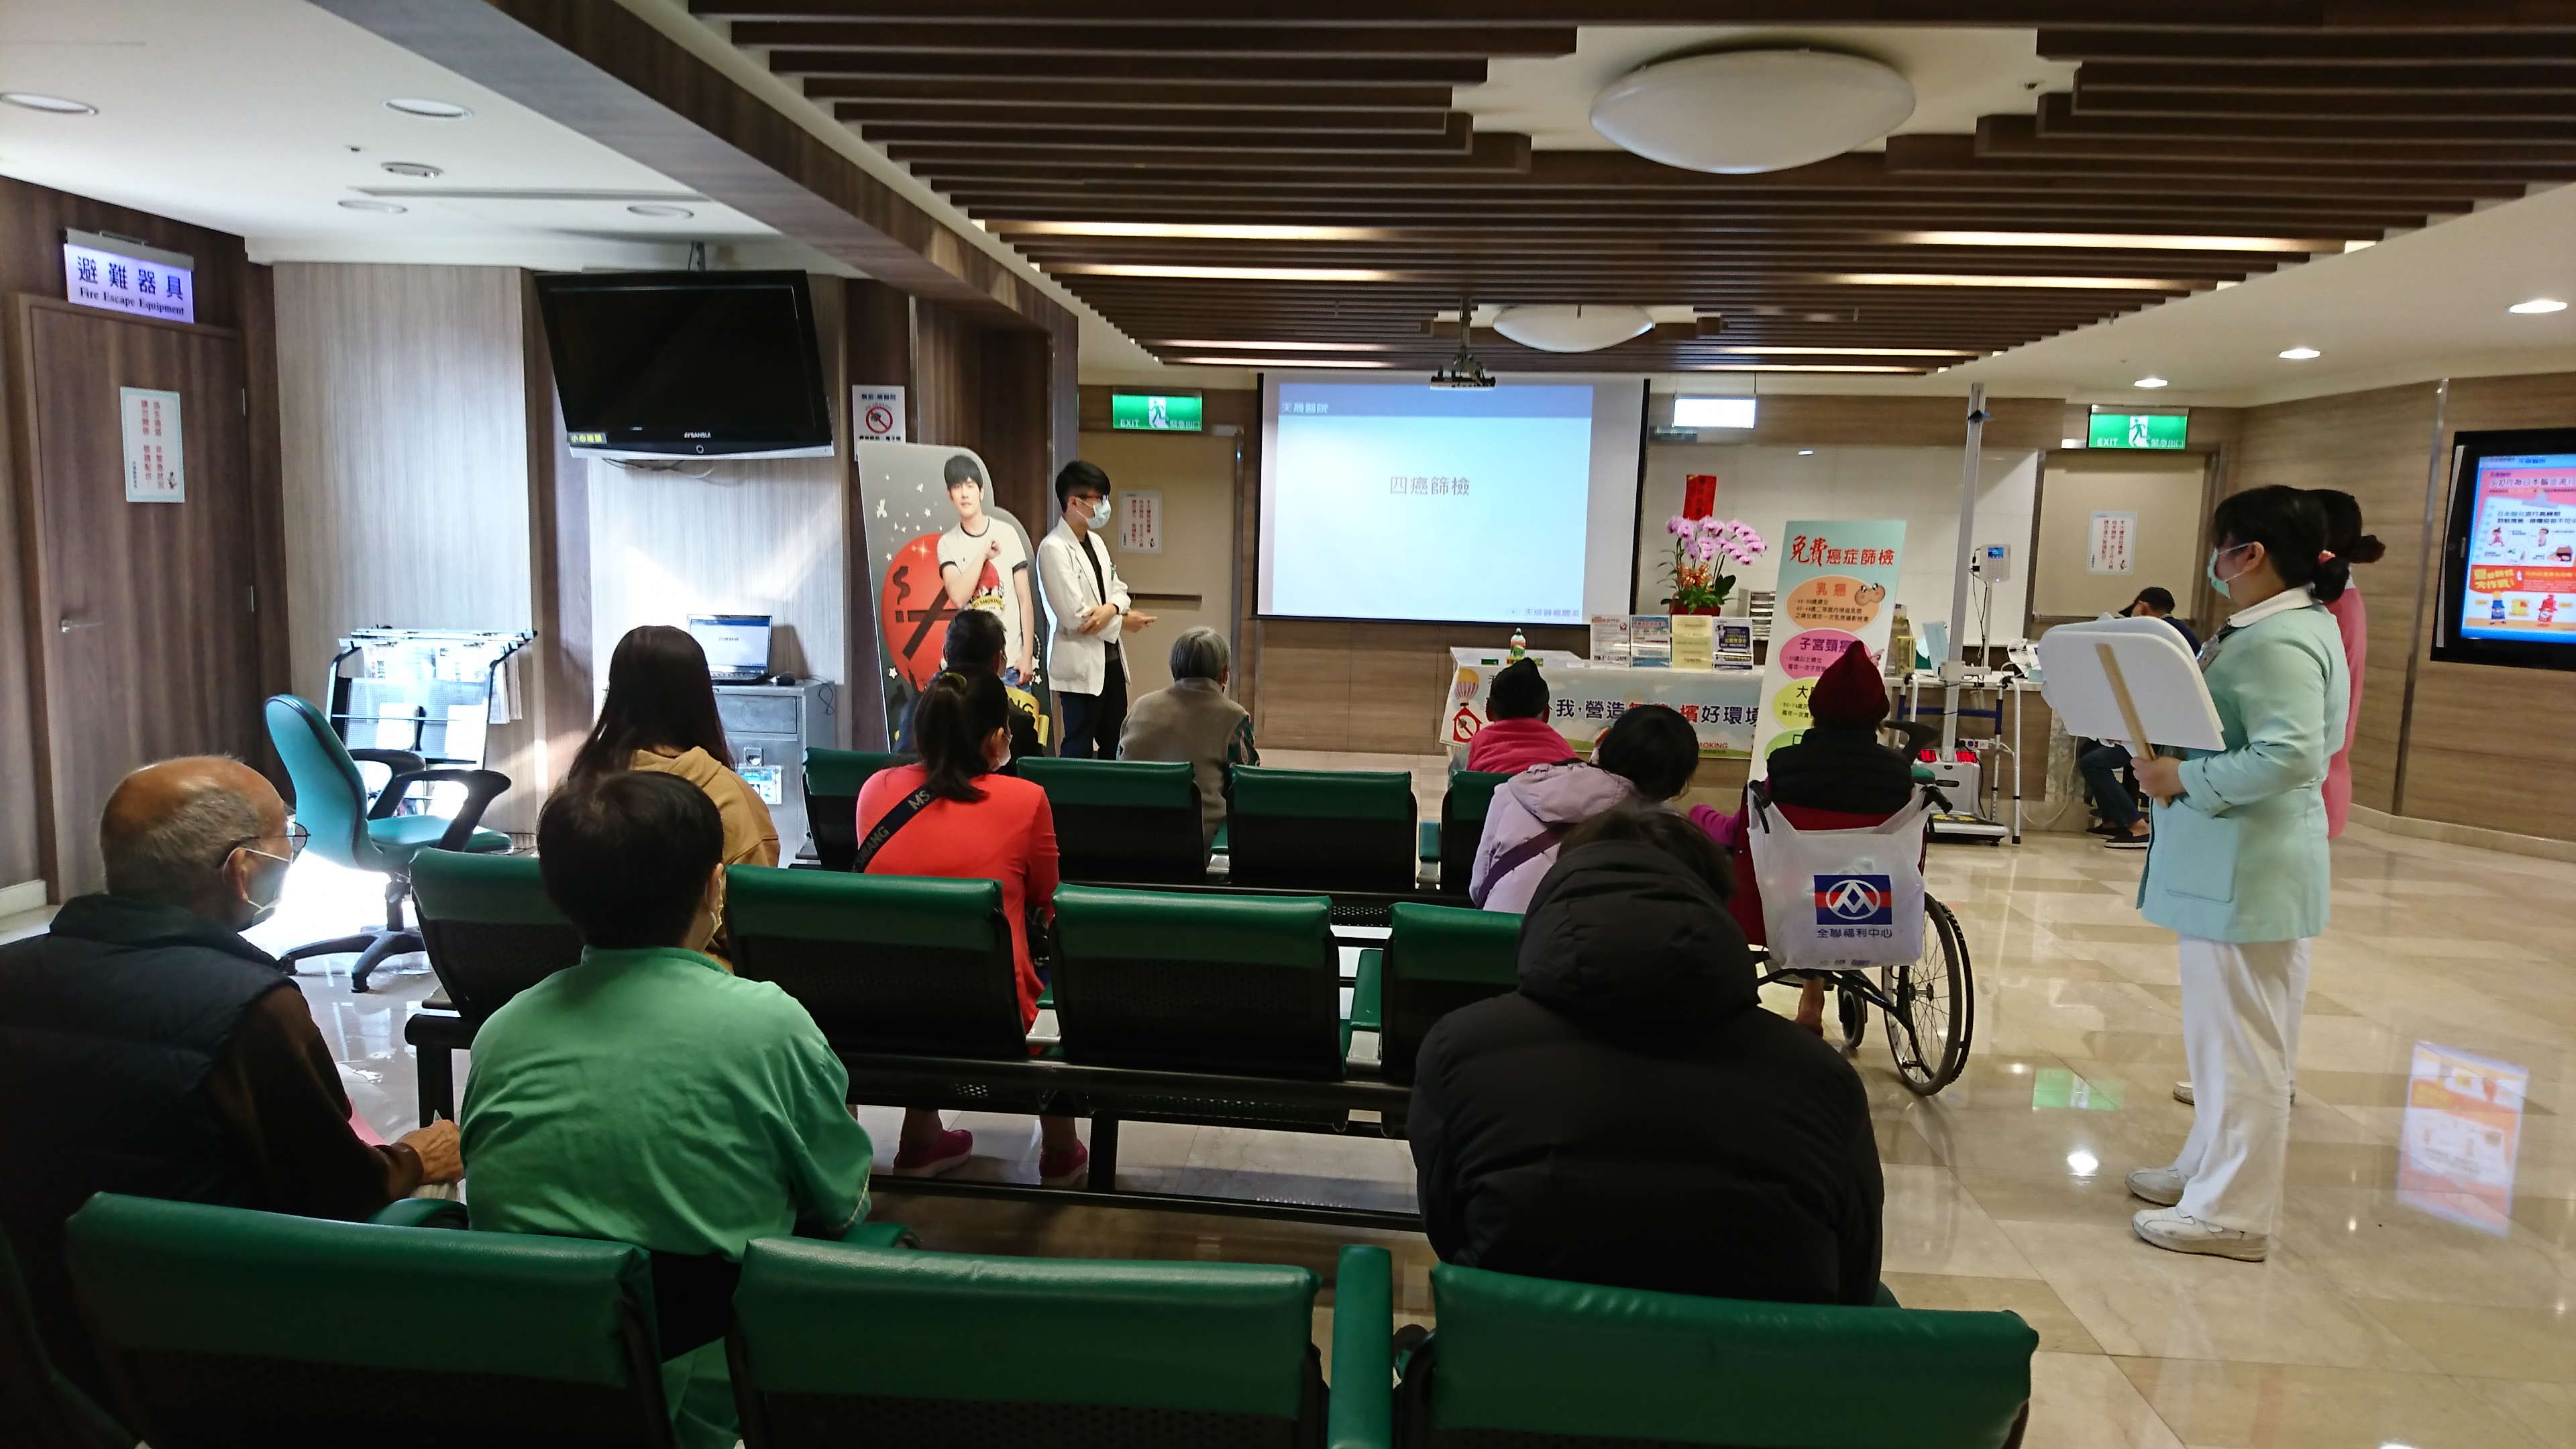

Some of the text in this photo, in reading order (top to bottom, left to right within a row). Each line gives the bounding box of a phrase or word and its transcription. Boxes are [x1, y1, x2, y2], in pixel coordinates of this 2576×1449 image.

[77, 256, 184, 301] 避難器具
[80, 287, 184, 315] Fire Escape Equipment
[1120, 419, 1140, 428] EXIT
[2097, 437, 2118, 447] EXIT
[1390, 476, 1469, 496] 四癌篩檢
[1788, 535, 1895, 568] 免費癌症篩檢
[1816, 582, 1847, 596] 乳癌
[1817, 928, 1893, 938] 全聯福利中心
